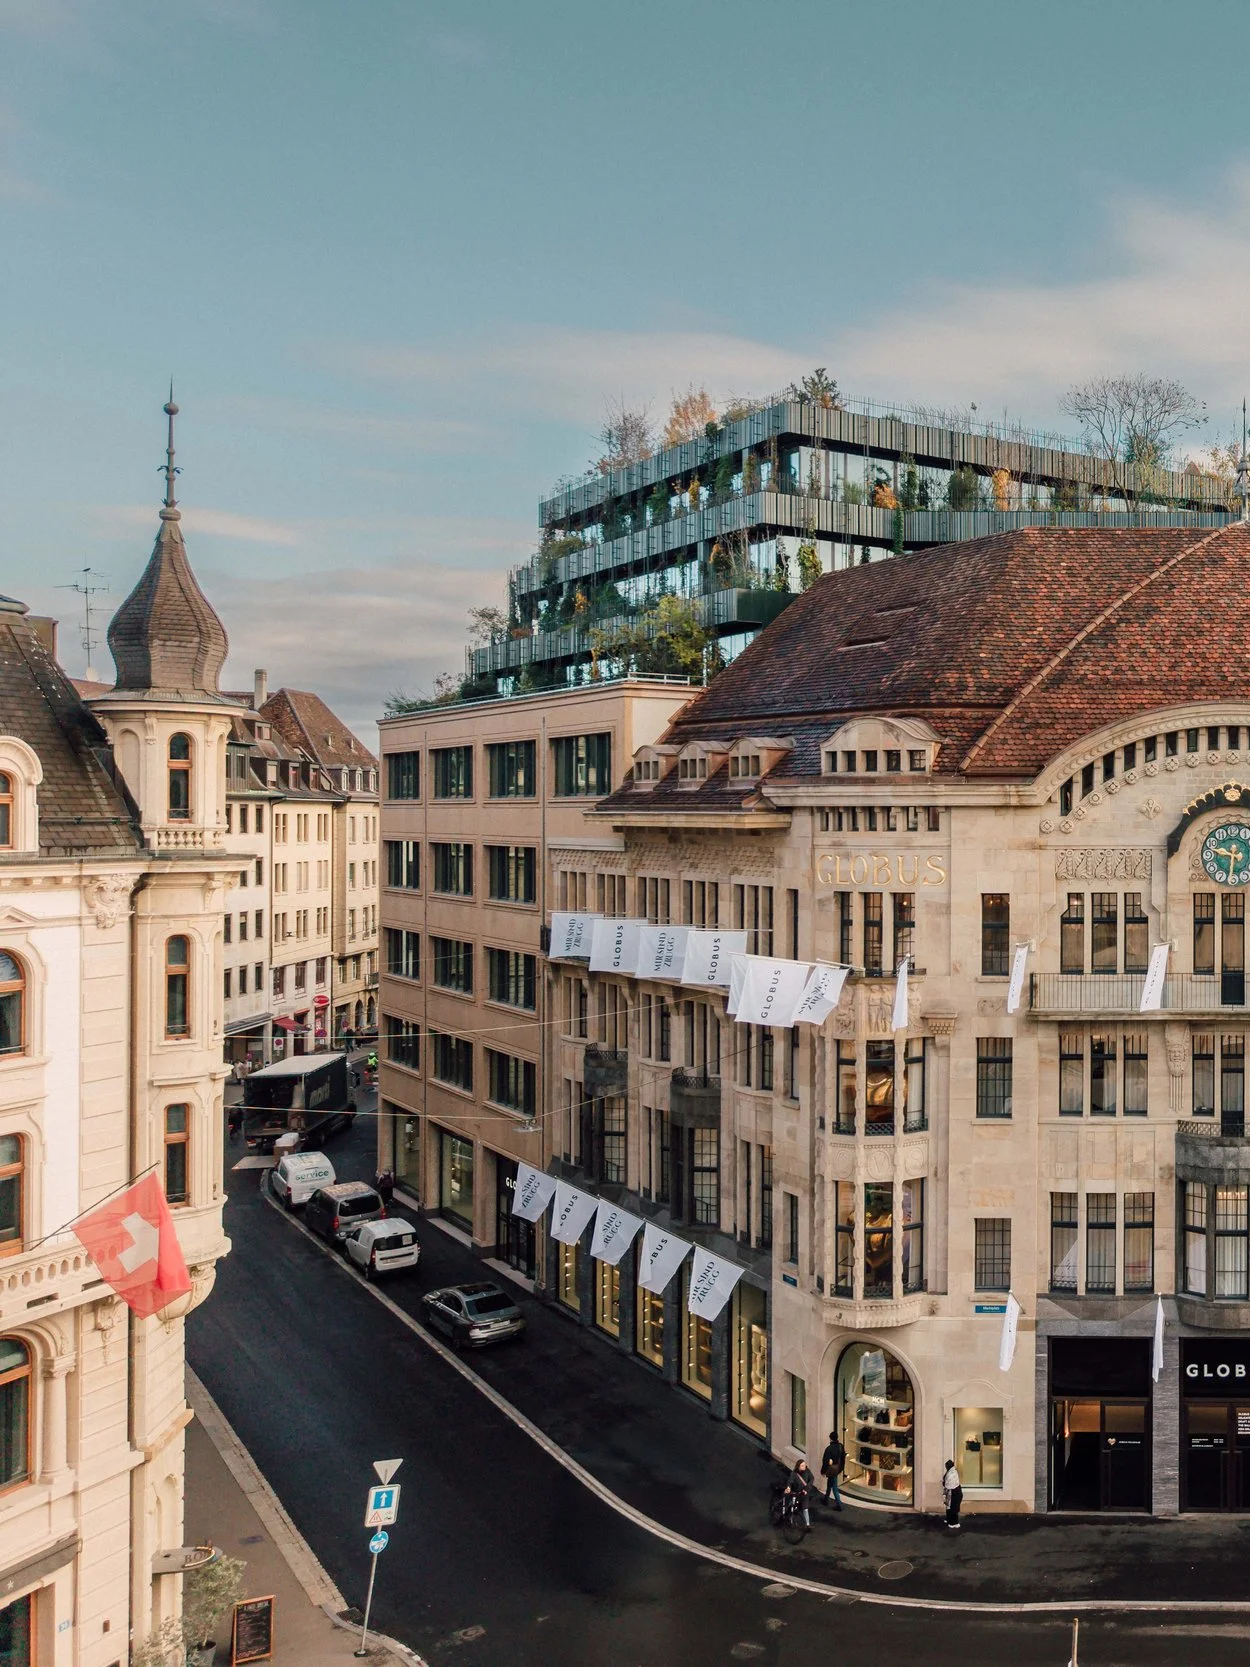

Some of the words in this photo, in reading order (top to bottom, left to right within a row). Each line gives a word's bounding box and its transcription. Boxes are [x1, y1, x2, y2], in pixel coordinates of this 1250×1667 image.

[816, 854, 947, 886] GLOBUS
[613, 925, 625, 967] GLOBUS
[707, 938, 721, 981] GLOBUS
[760, 970, 781, 1019] GLOBUS
[295, 1169, 330, 1181] service
[696, 1269, 720, 1303] ZRUGG
[697, 1261, 715, 1284] SIND
